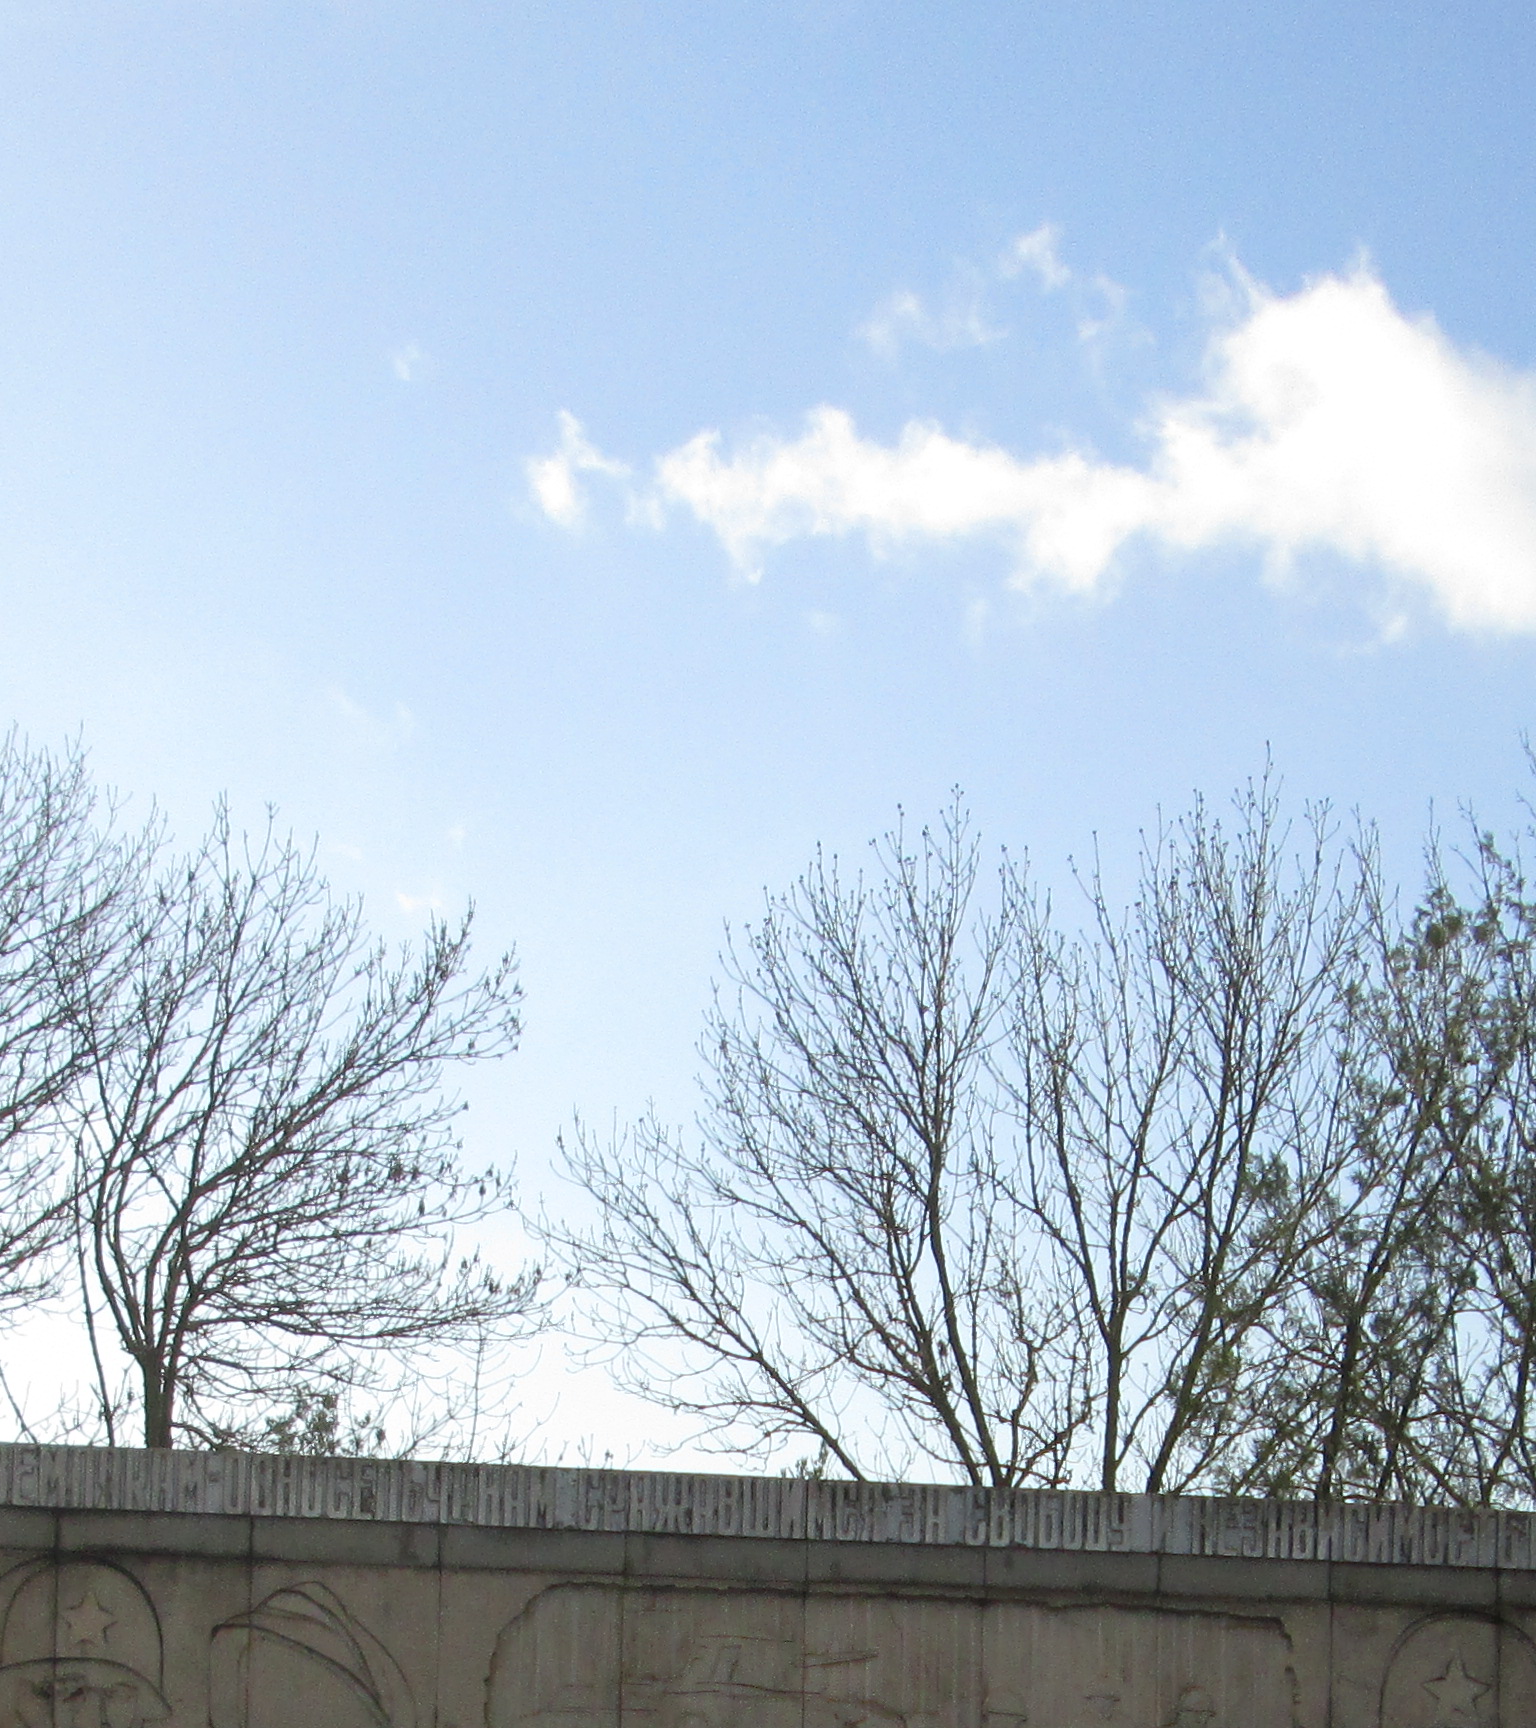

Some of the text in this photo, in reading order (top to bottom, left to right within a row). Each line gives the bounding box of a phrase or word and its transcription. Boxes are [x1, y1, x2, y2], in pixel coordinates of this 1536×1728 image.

[579, 1469, 885, 1542] СРАЖАВШИМСЯ
[900, 1485, 946, 1544] ЗА
[965, 1490, 1130, 1552] СВОБОДУ
[1152, 1496, 1173, 1553] И
[1193, 1498, 1518, 1568] НЕЗАВИСИМОСТЬ
